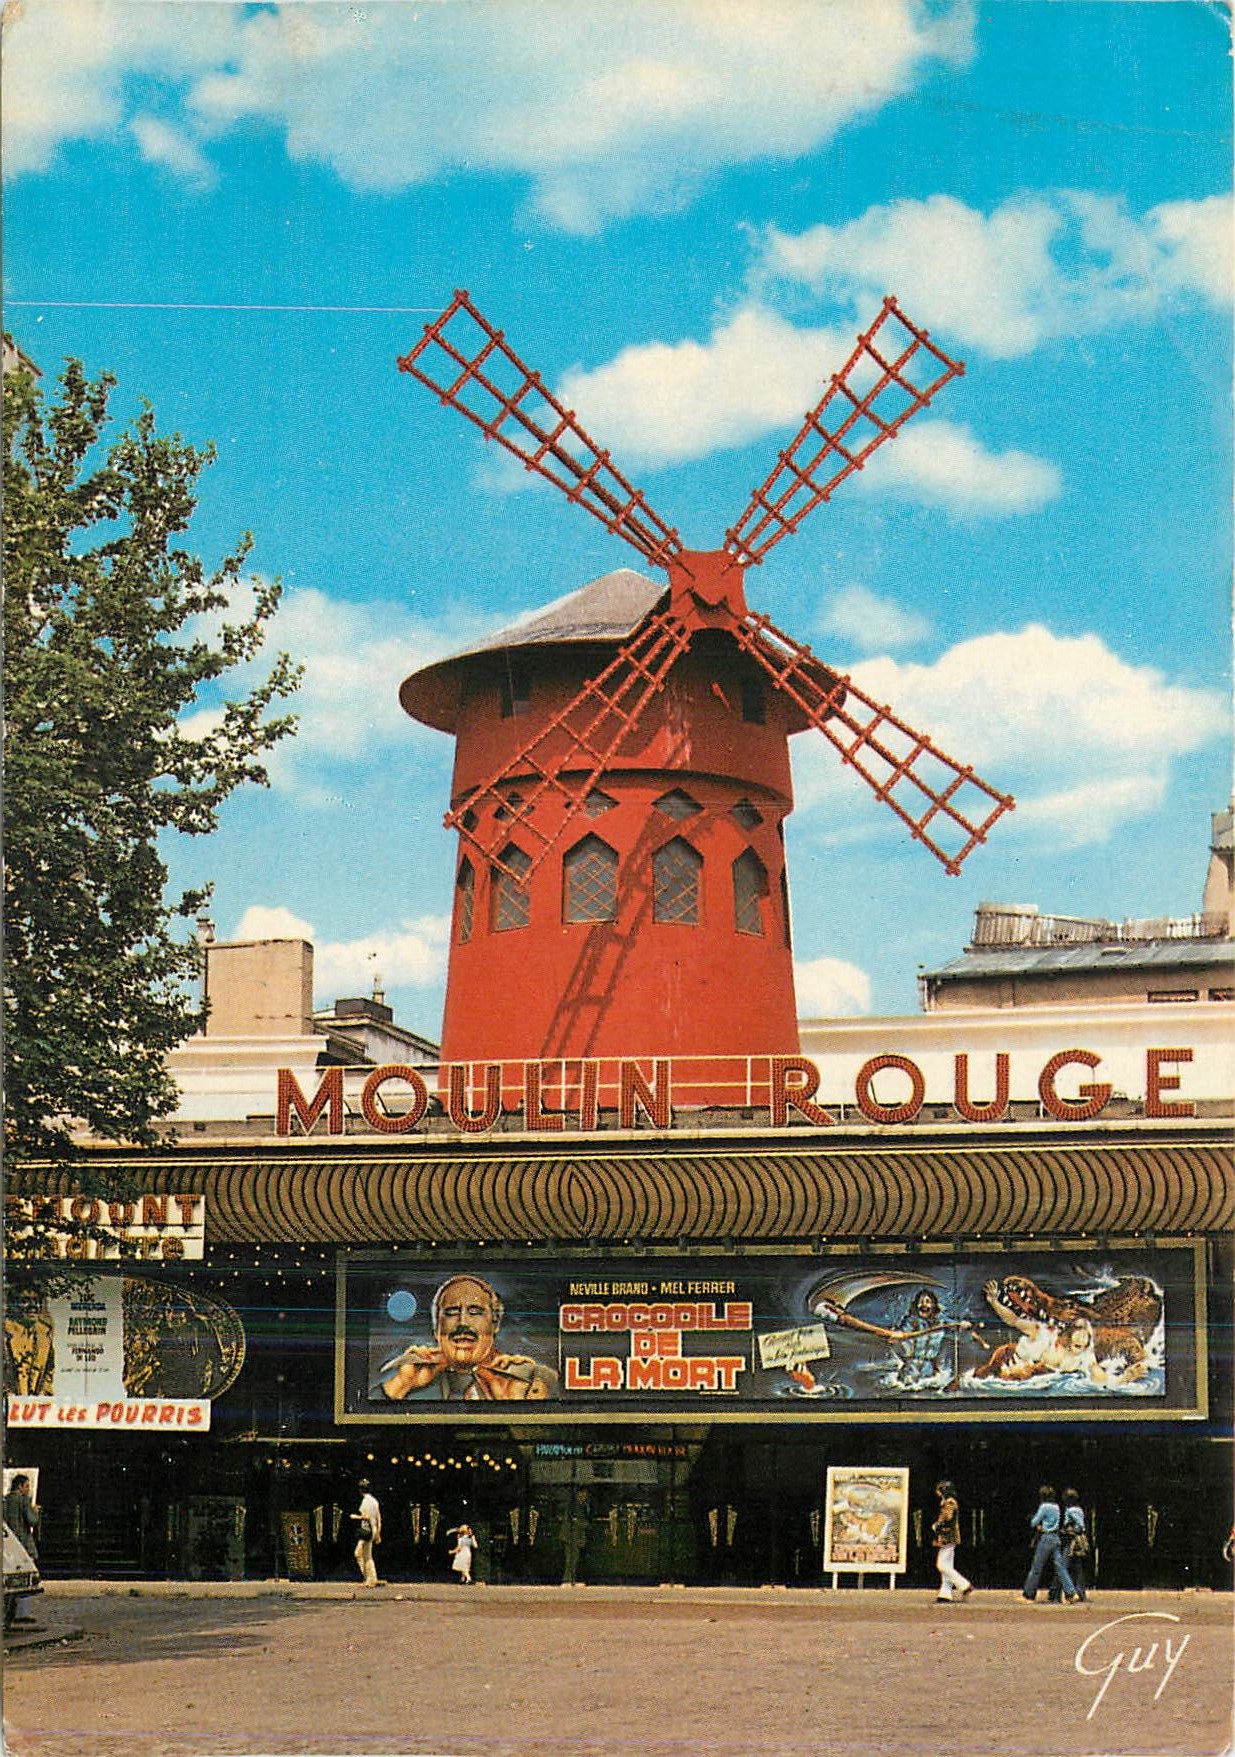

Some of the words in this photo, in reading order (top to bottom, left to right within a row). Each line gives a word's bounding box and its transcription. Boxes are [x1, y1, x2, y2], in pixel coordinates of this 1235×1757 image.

[274, 1058, 671, 1137] MOULIN
[769, 1047, 1196, 1126] ROUGE
[569, 1282, 609, 1296] NEVILLE
[612, 1281, 649, 1295] BRAND
[660, 1281, 686, 1294] MEL
[687, 1280, 736, 1295] FERRER
[560, 1302, 753, 1332] CROCODILE
[630, 1331, 682, 1358] DE
[565, 1357, 623, 1390] LA
[627, 1356, 746, 1390] MORT
[9, 1402, 52, 1422] LUT
[57, 1407, 87, 1423] LES
[96, 1401, 203, 1426] POURRIS
